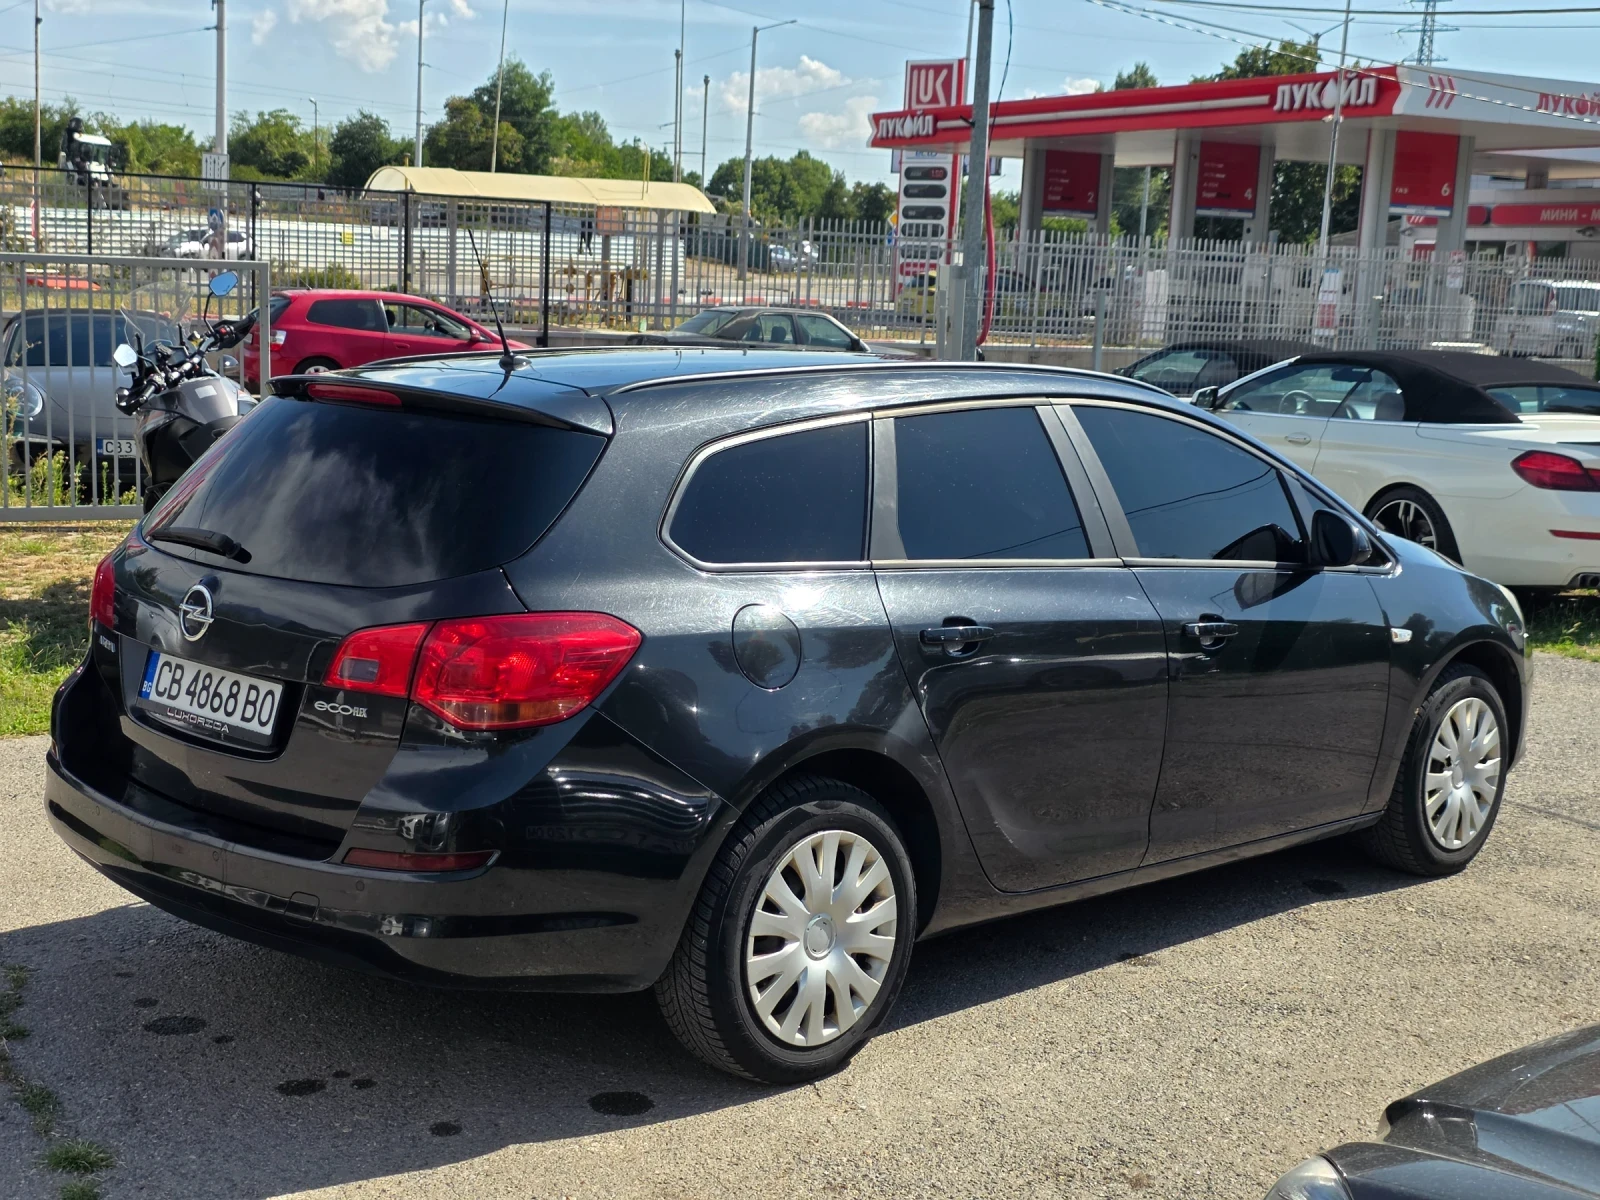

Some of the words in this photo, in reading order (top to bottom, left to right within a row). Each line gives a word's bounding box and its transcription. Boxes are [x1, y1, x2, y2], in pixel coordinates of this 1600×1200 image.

[1273, 72, 1376, 112] ЛУКОЙЛ
[876, 110, 934, 139] ЛУКОЙЛ
[1244, 188, 1253, 201] 4
[1441, 182, 1451, 197] 6
[1087, 191, 1095, 204] 2
[1540, 207, 1578, 222] МИНИ
[142, 680, 153, 693] BG
[185, 669, 241, 718] 4868
